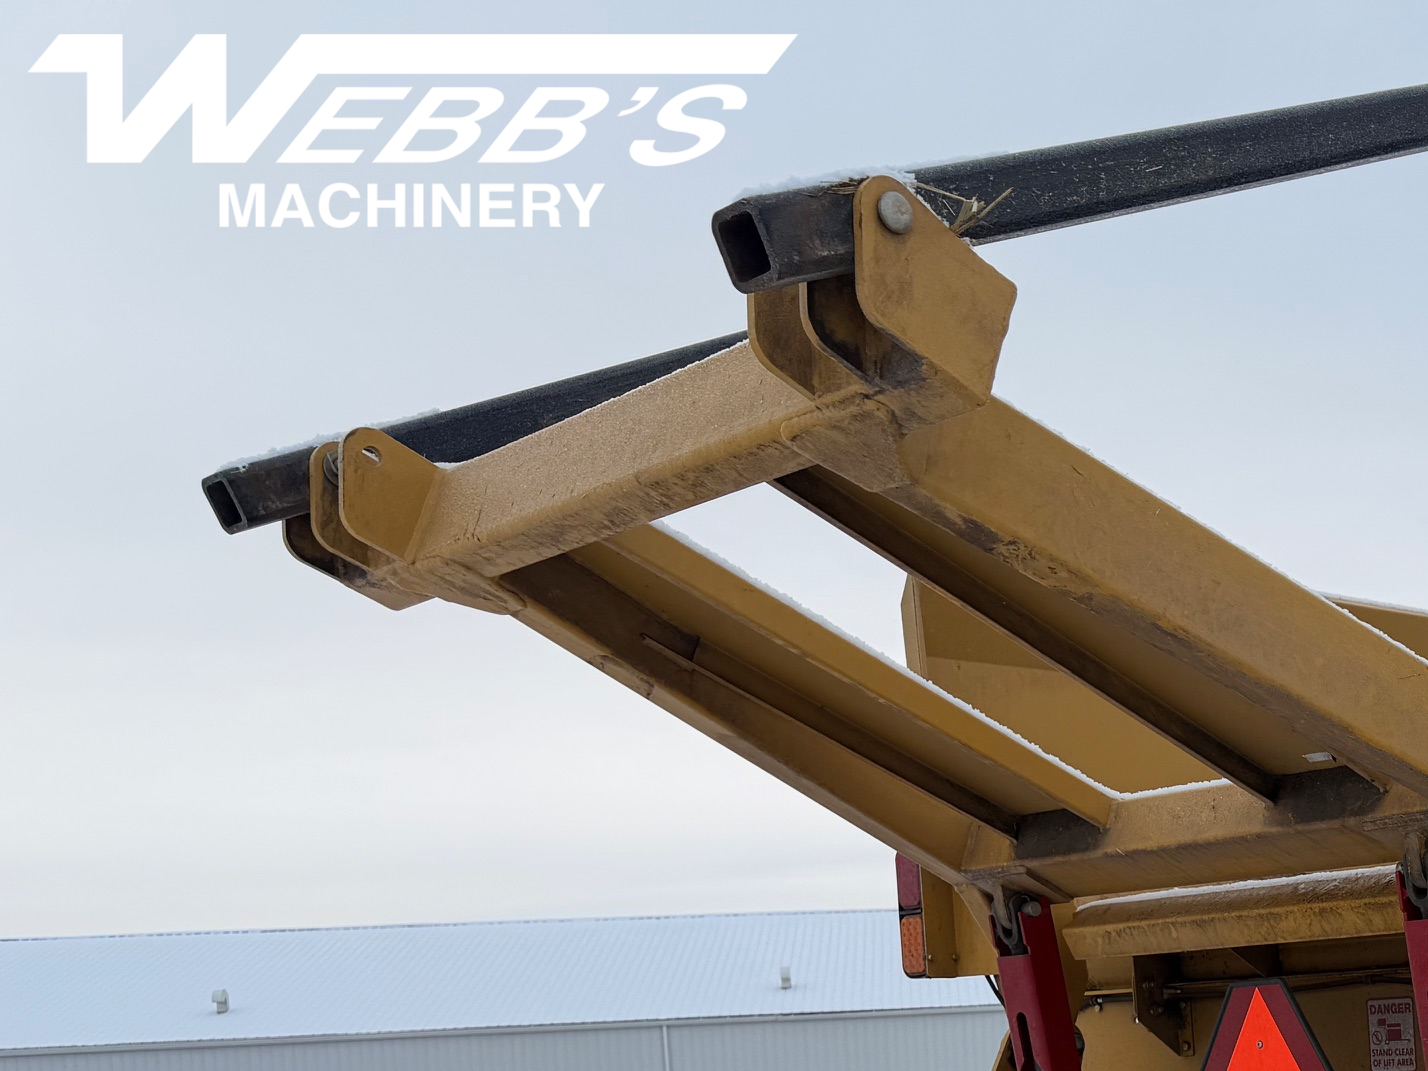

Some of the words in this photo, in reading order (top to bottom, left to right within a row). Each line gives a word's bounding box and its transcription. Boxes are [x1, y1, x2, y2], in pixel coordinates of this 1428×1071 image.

[1369, 1002, 1411, 1015] DANGER
[1372, 1049, 1393, 1057] STAND
[1394, 1048, 1414, 1056] CLEAR
[1373, 1059, 1382, 1067] OF
[1383, 1058, 1395, 1067] LIFT
[1397, 1058, 1414, 1066] AREA
